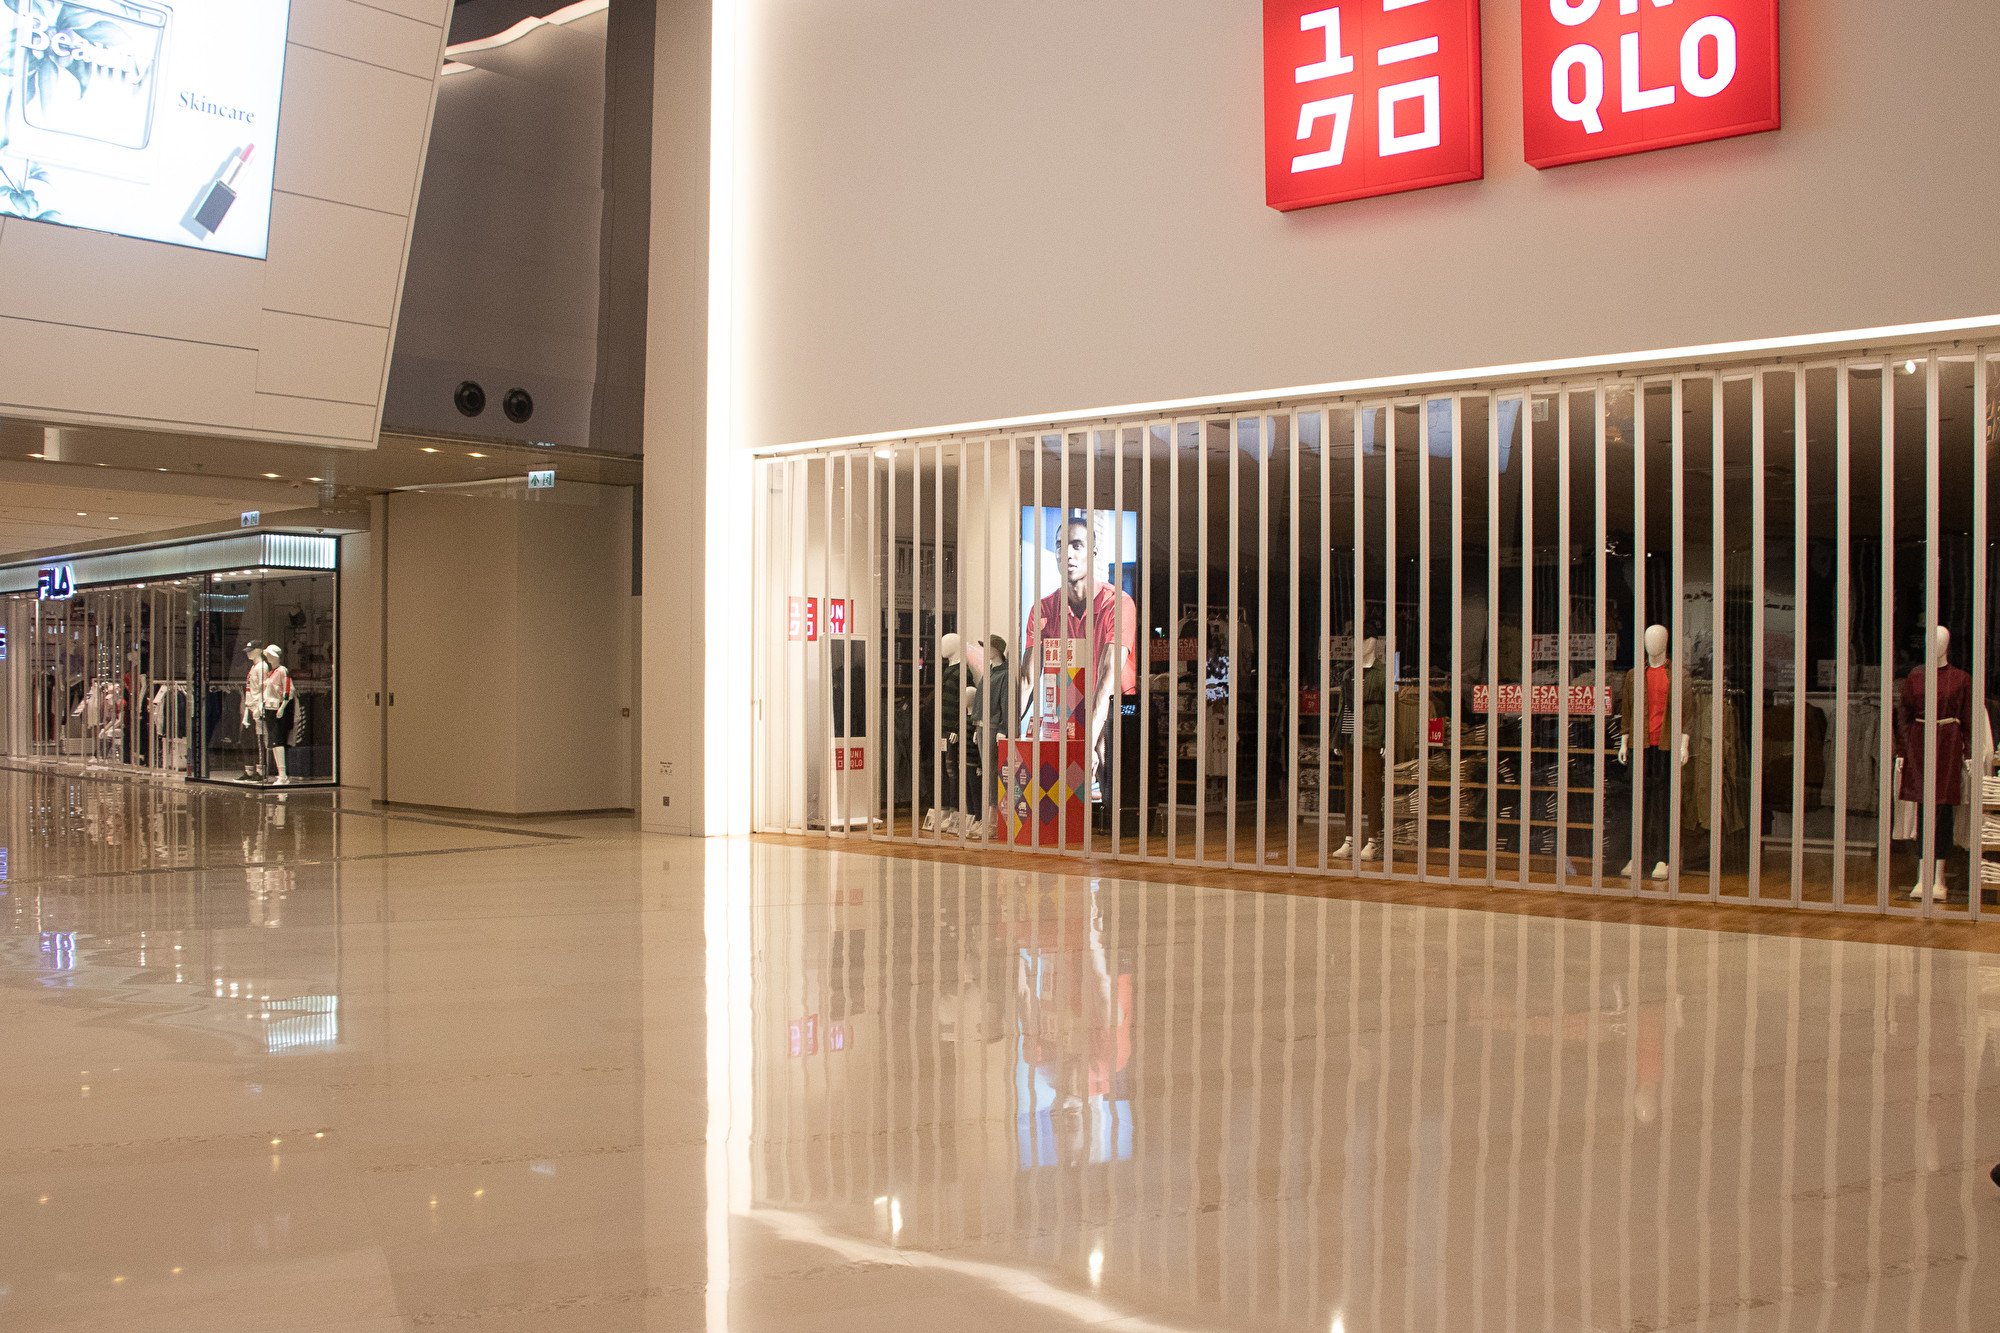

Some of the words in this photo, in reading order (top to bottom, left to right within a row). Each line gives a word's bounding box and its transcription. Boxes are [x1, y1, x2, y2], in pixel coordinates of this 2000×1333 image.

[1551, 15, 1737, 135] QLO
[178, 90, 256, 124] Skincare
[38, 565, 74, 600] FILA
[1473, 686, 1506, 698] SAE
[1506, 686, 1540, 698] SAE
[1540, 686, 1575, 699] SAE
